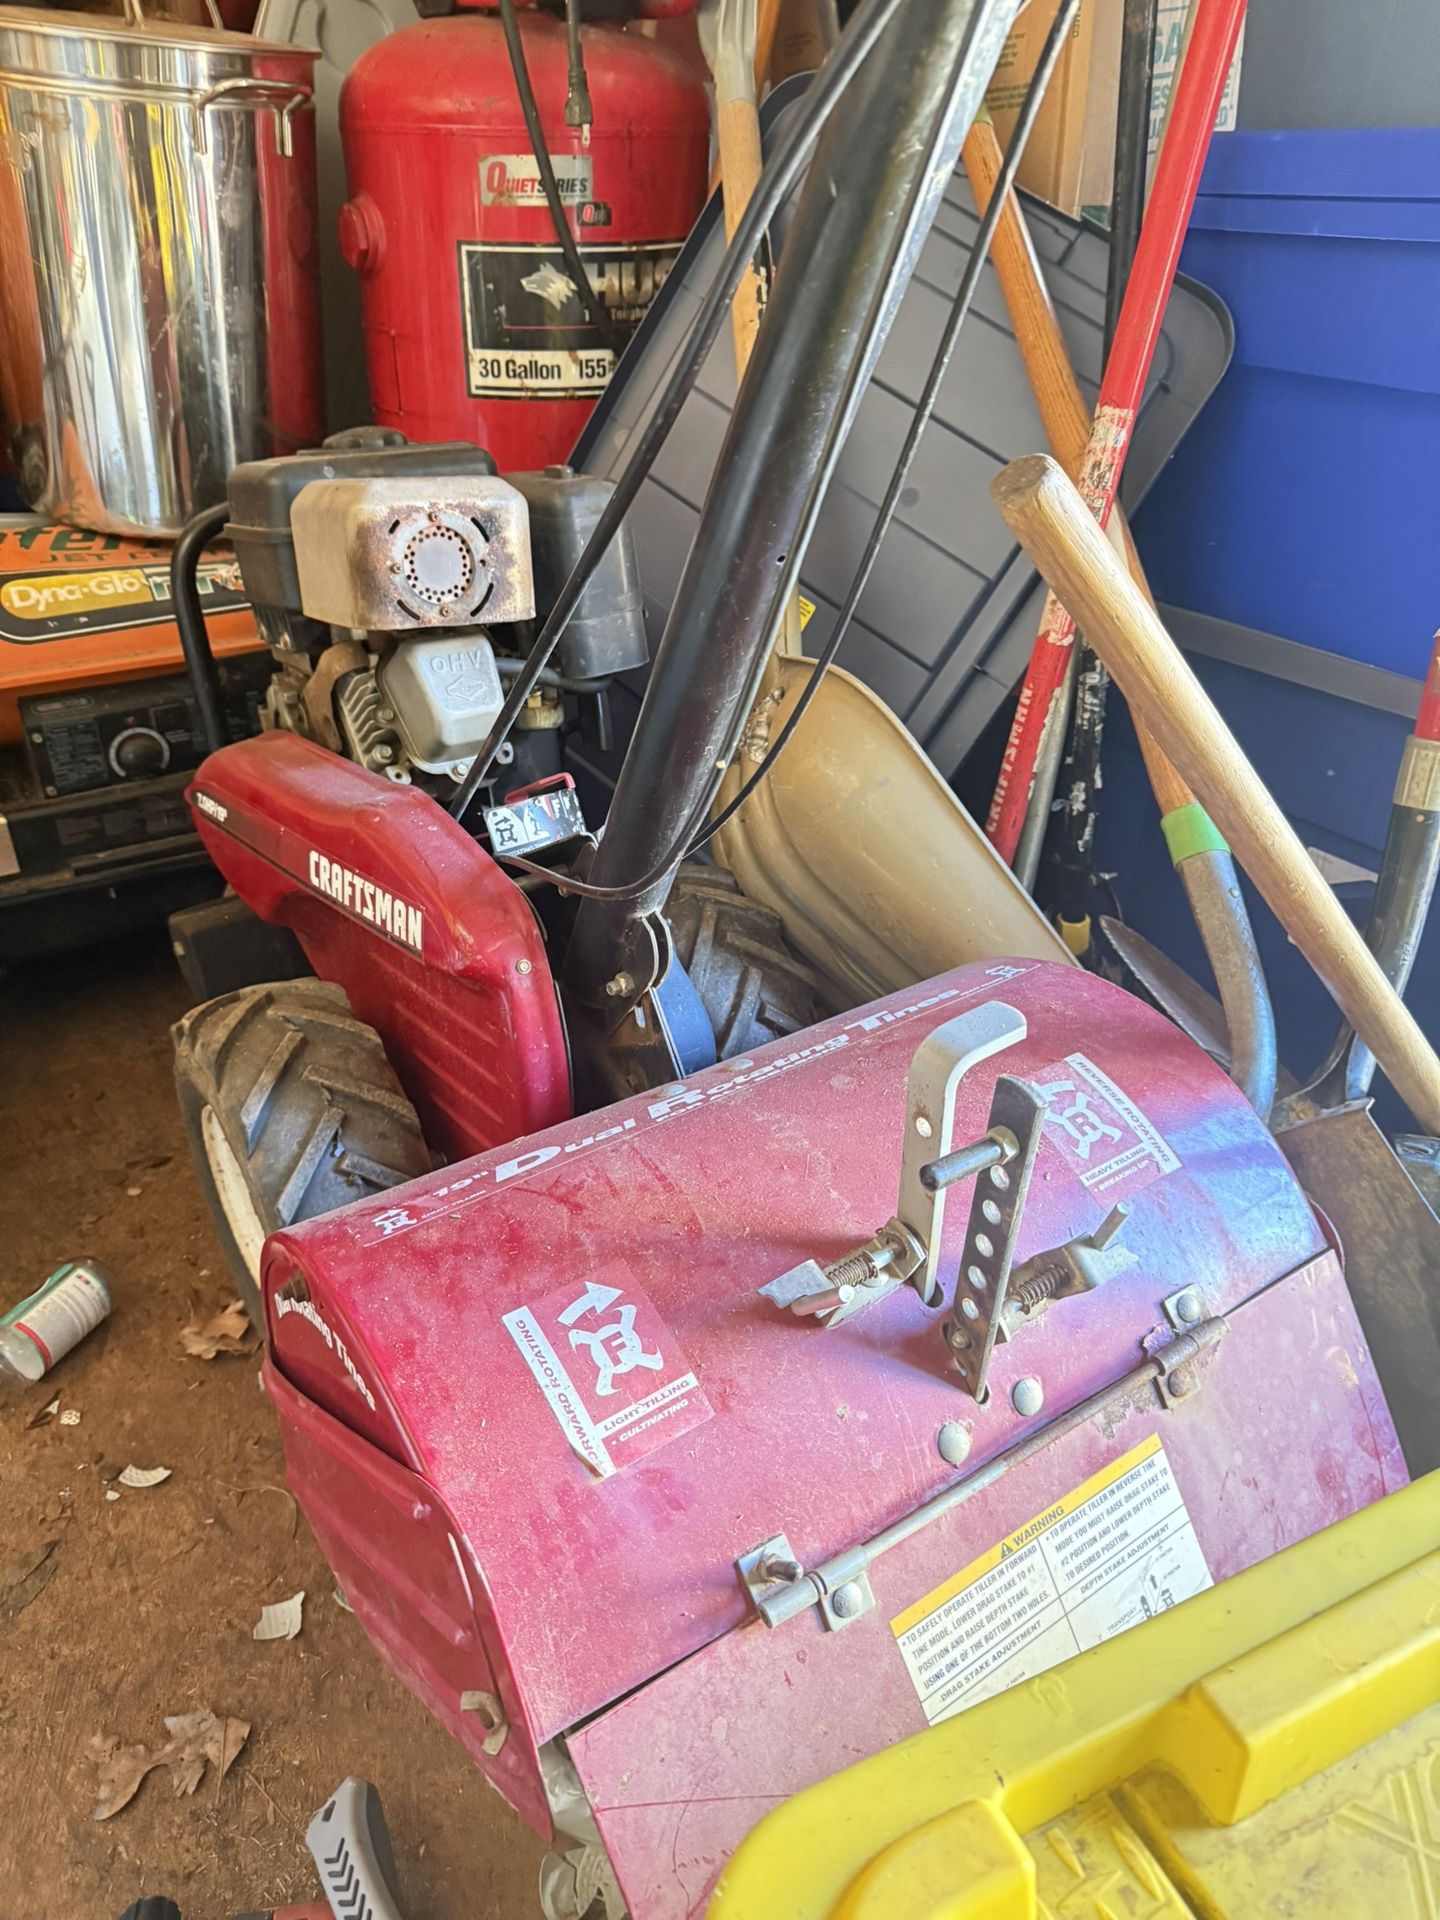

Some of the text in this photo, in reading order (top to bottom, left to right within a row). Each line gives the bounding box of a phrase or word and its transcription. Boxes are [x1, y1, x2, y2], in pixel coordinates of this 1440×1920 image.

[478, 358, 501, 379] 30
[505, 359, 561, 380] Gallon
[8, 575, 142, 612] Dyna-Glo
[430, 650, 482, 673] OHV
[309, 850, 424, 951] CRAFTSMAN
[432, 988, 961, 1197] 19" Dual Rotating Tines
[1077, 1061, 1171, 1163] REVERSE ROTATING
[1085, 1147, 1146, 1182] HEAVY TILLING
[1100, 1166, 1138, 1190] BREAKING
[332, 1330, 376, 1412] Tines
[515, 1319, 561, 1390] ROTATING
[604, 1380, 690, 1432] LIGHT TILLING
[619, 1399, 689, 1441] CULTIVATING
[1013, 1506, 1065, 1546] WARNING
[1050, 1458, 1156, 1540] TO OPERATE TILLER IN REVERSE TINE
[1055, 1467, 1168, 1554] MODE YOU MUST RAISE DRAG STAKE TO
[1061, 1482, 1171, 1568] #2 POSITION AND LOWER DEPTH STAKE
[906, 1545, 1038, 1645] TO SAFELY OPERATE TILLER IN FORWARD
[1065, 1570, 1075, 1582] TO
[1075, 1550, 1101, 1573] DESIRED
[1080, 1574, 1104, 1594] DEPTH
[1103, 1558, 1127, 1577] STAKE
[1127, 1523, 1170, 1559] ADJUSTMENT
[912, 1643, 929, 1660] TINE
[952, 1608, 977, 1630] LOWER
[976, 1593, 996, 1611] DRAG
[995, 1578, 1018, 1598] STAKE
[1016, 1570, 1027, 1582] TO
[1026, 1564, 1036, 1574] #1
[918, 1586, 1030, 1675] POSITION AND RAISE DEPTH STAKE
[923, 1669, 945, 1690] USING
[945, 1657, 960, 1673] ONE
[960, 1649, 969, 1662] OF
[970, 1640, 984, 1655] THE
[983, 1617, 1013, 1642] BOTTOM
[1011, 1606, 1028, 1623] TWO
[1107, 1606, 1138, 1633] TRANSPORT
[940, 1678, 964, 1703] DRAG
[964, 1661, 991, 1683] STAKE
[991, 1619, 1043, 1664] ADJUSTMENT
